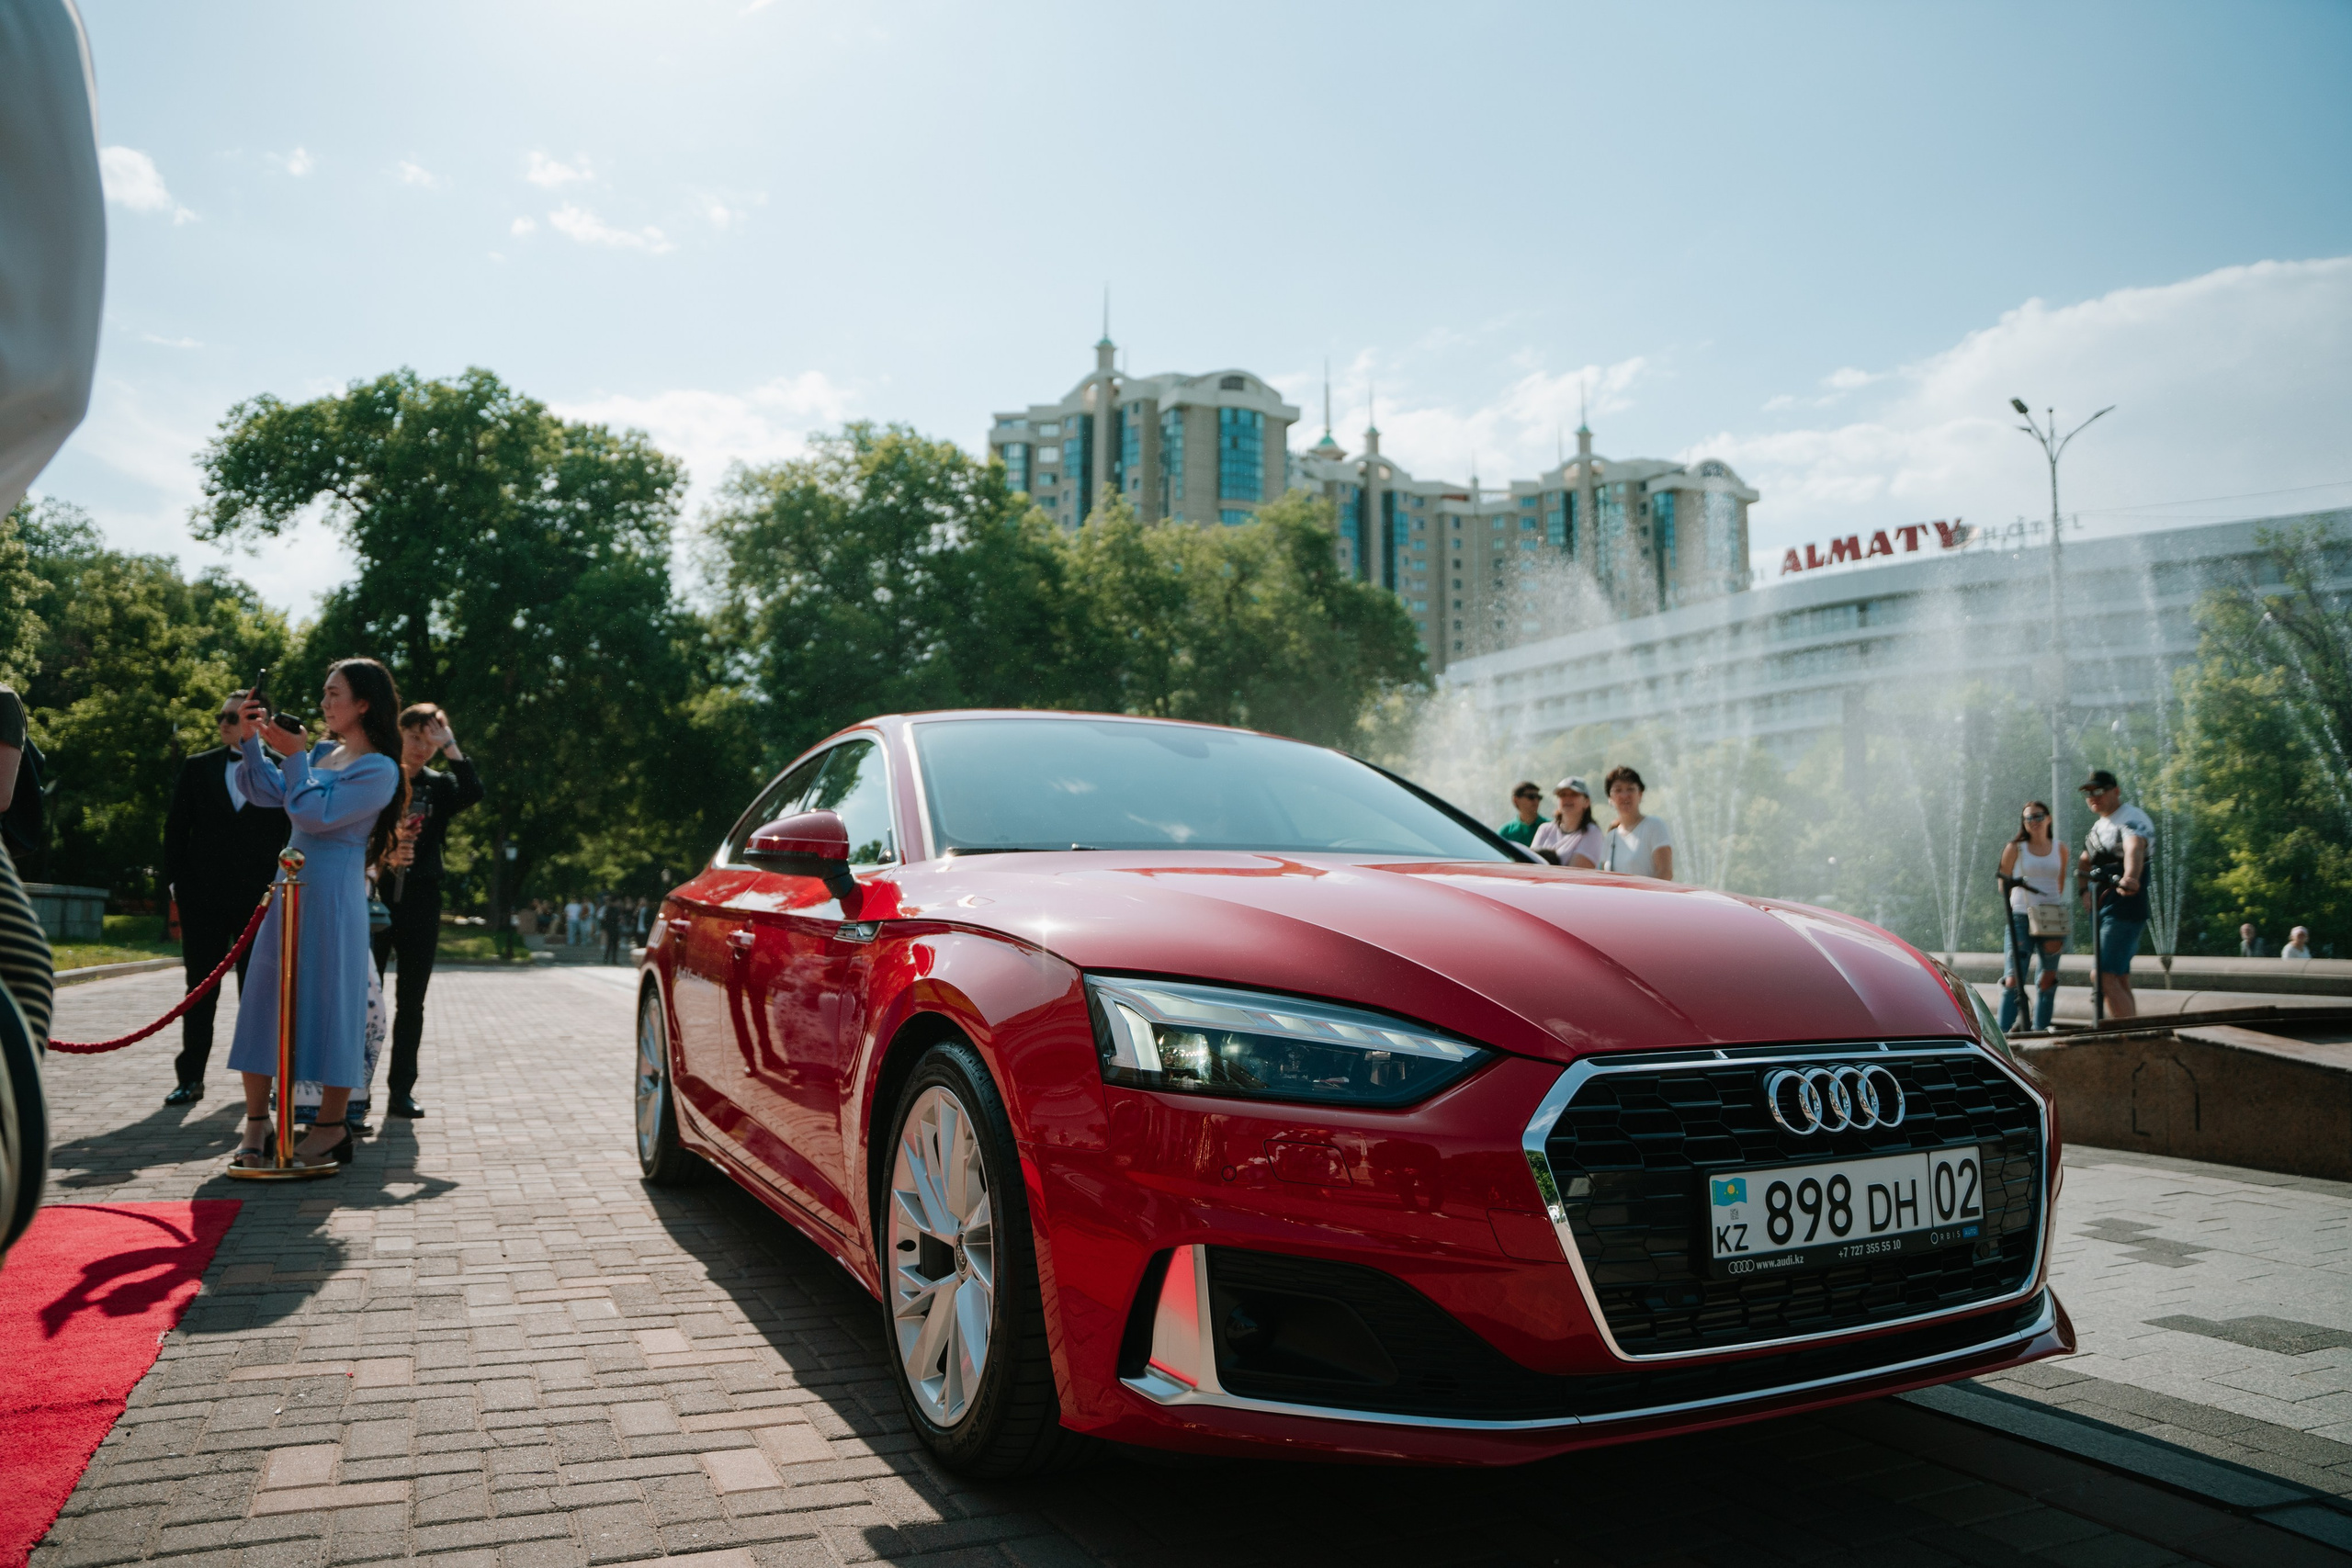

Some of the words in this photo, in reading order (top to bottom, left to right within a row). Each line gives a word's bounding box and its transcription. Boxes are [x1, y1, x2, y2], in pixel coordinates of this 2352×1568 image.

[1781, 517, 1962, 576] ALMATY
[1765, 1173, 1853, 1246] 898
[1867, 1179, 1919, 1233] DH
[1935, 1157, 1980, 1222] 02
[1715, 1223, 1749, 1254] KZ
[1838, 1247, 1849, 1259] +7
[1850, 1245, 1864, 1258] 727
[1866, 1242, 1880, 1255] 355
[1881, 1240, 1892, 1253] 55
[1893, 1239, 1902, 1251] 10
[1756, 1255, 1804, 1269] www.audi.kz
